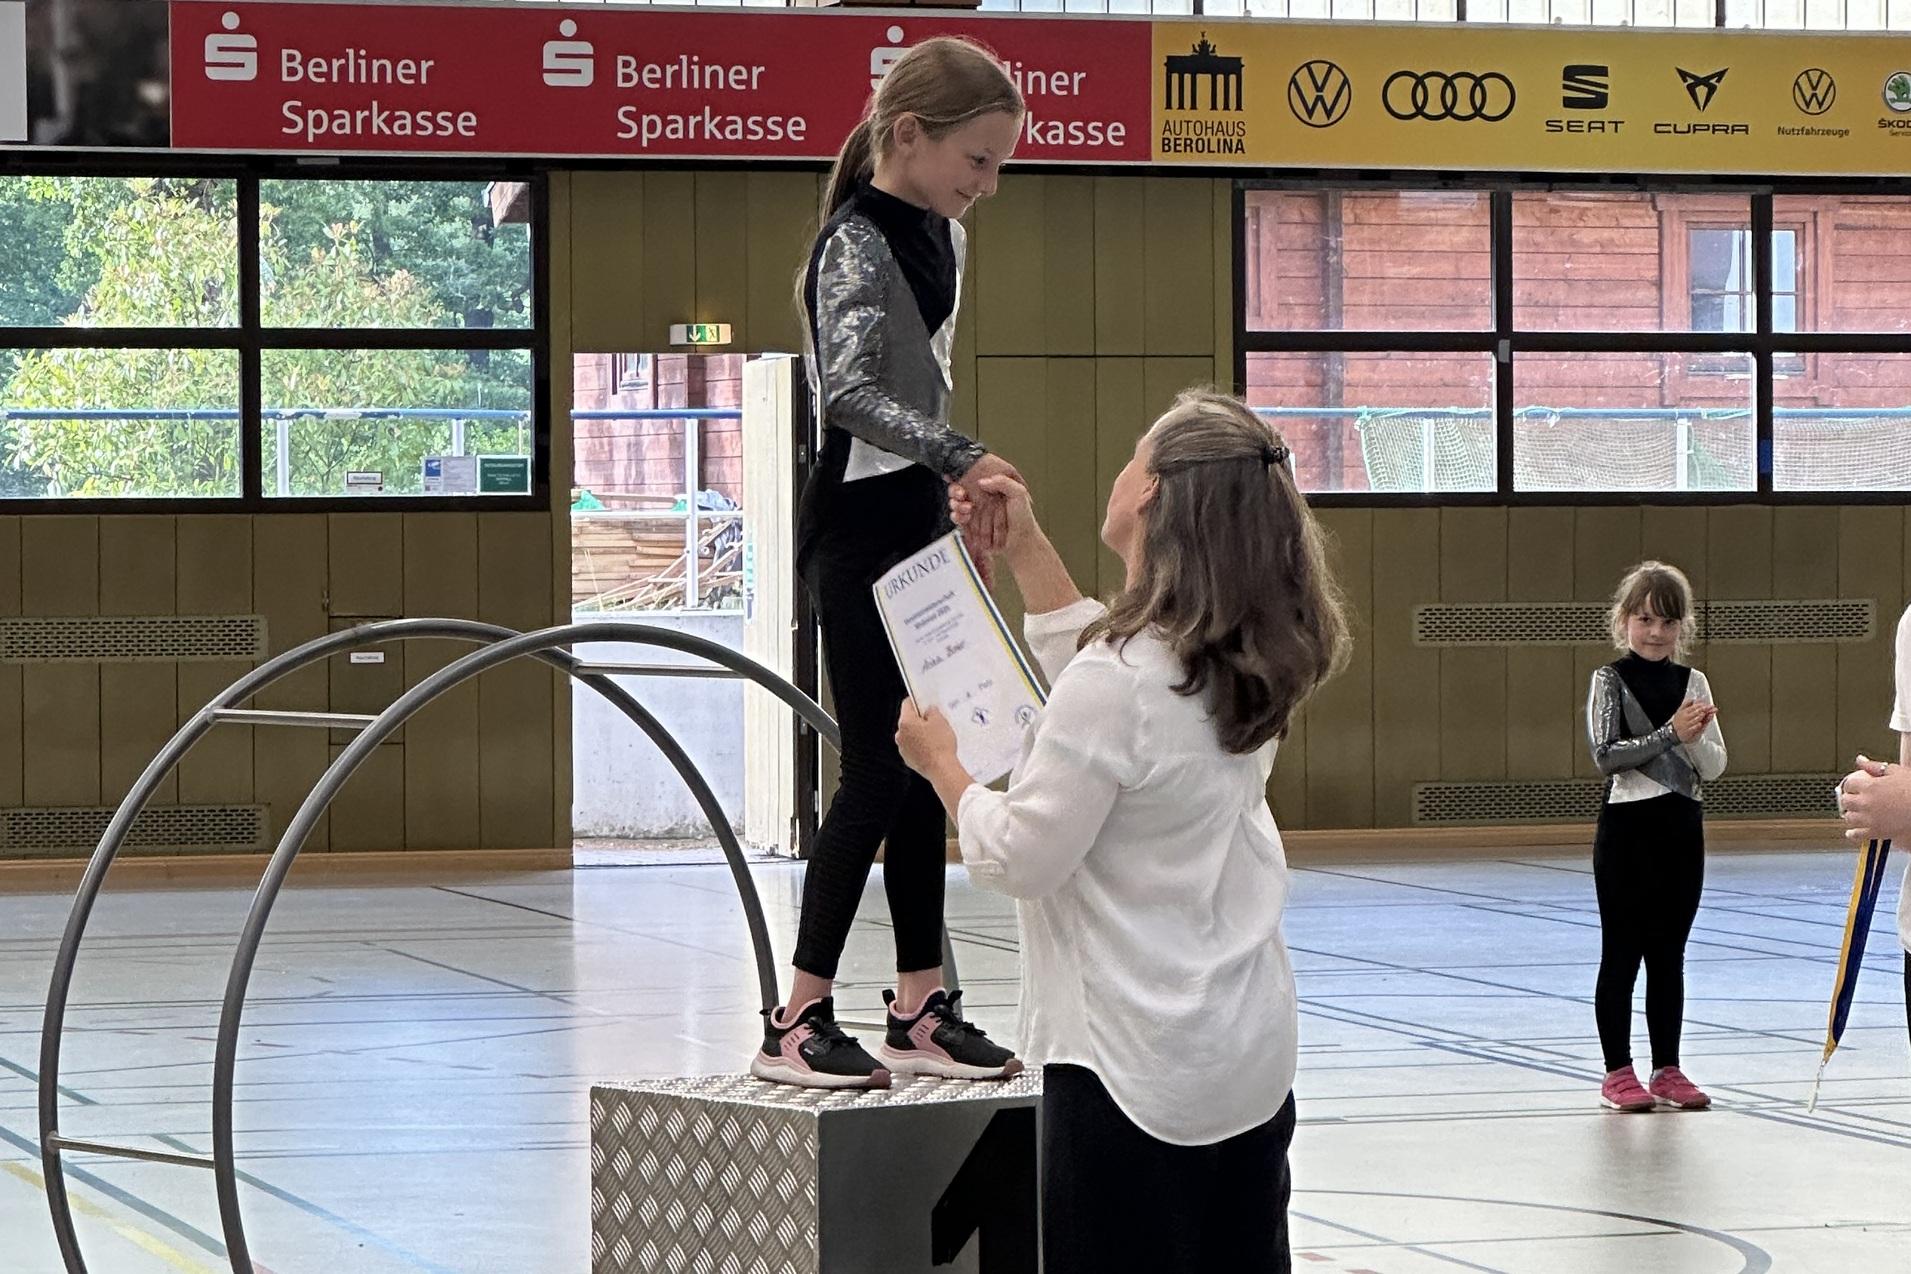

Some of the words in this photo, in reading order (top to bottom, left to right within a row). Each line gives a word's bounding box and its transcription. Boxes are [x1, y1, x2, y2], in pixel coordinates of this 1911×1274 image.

[281, 48, 434, 84] Berliner
[617, 54, 765, 90] Berliner
[1002, 60, 1087, 95] liner
[282, 100, 477, 142] Sparkasse
[617, 105, 807, 147] Sparkasse
[1026, 111, 1126, 146] kasse
[1162, 119, 1246, 137] AUTOHAUS
[1545, 119, 1625, 133] SEAT
[1653, 123, 1749, 136] CUPRA
[1777, 126, 1850, 138] Nutzfahrzeuge
[1161, 138, 1246, 154] BEROLINA
[884, 547, 950, 600] URKUNDE
[931, 1106, 1038, 1274] 1
